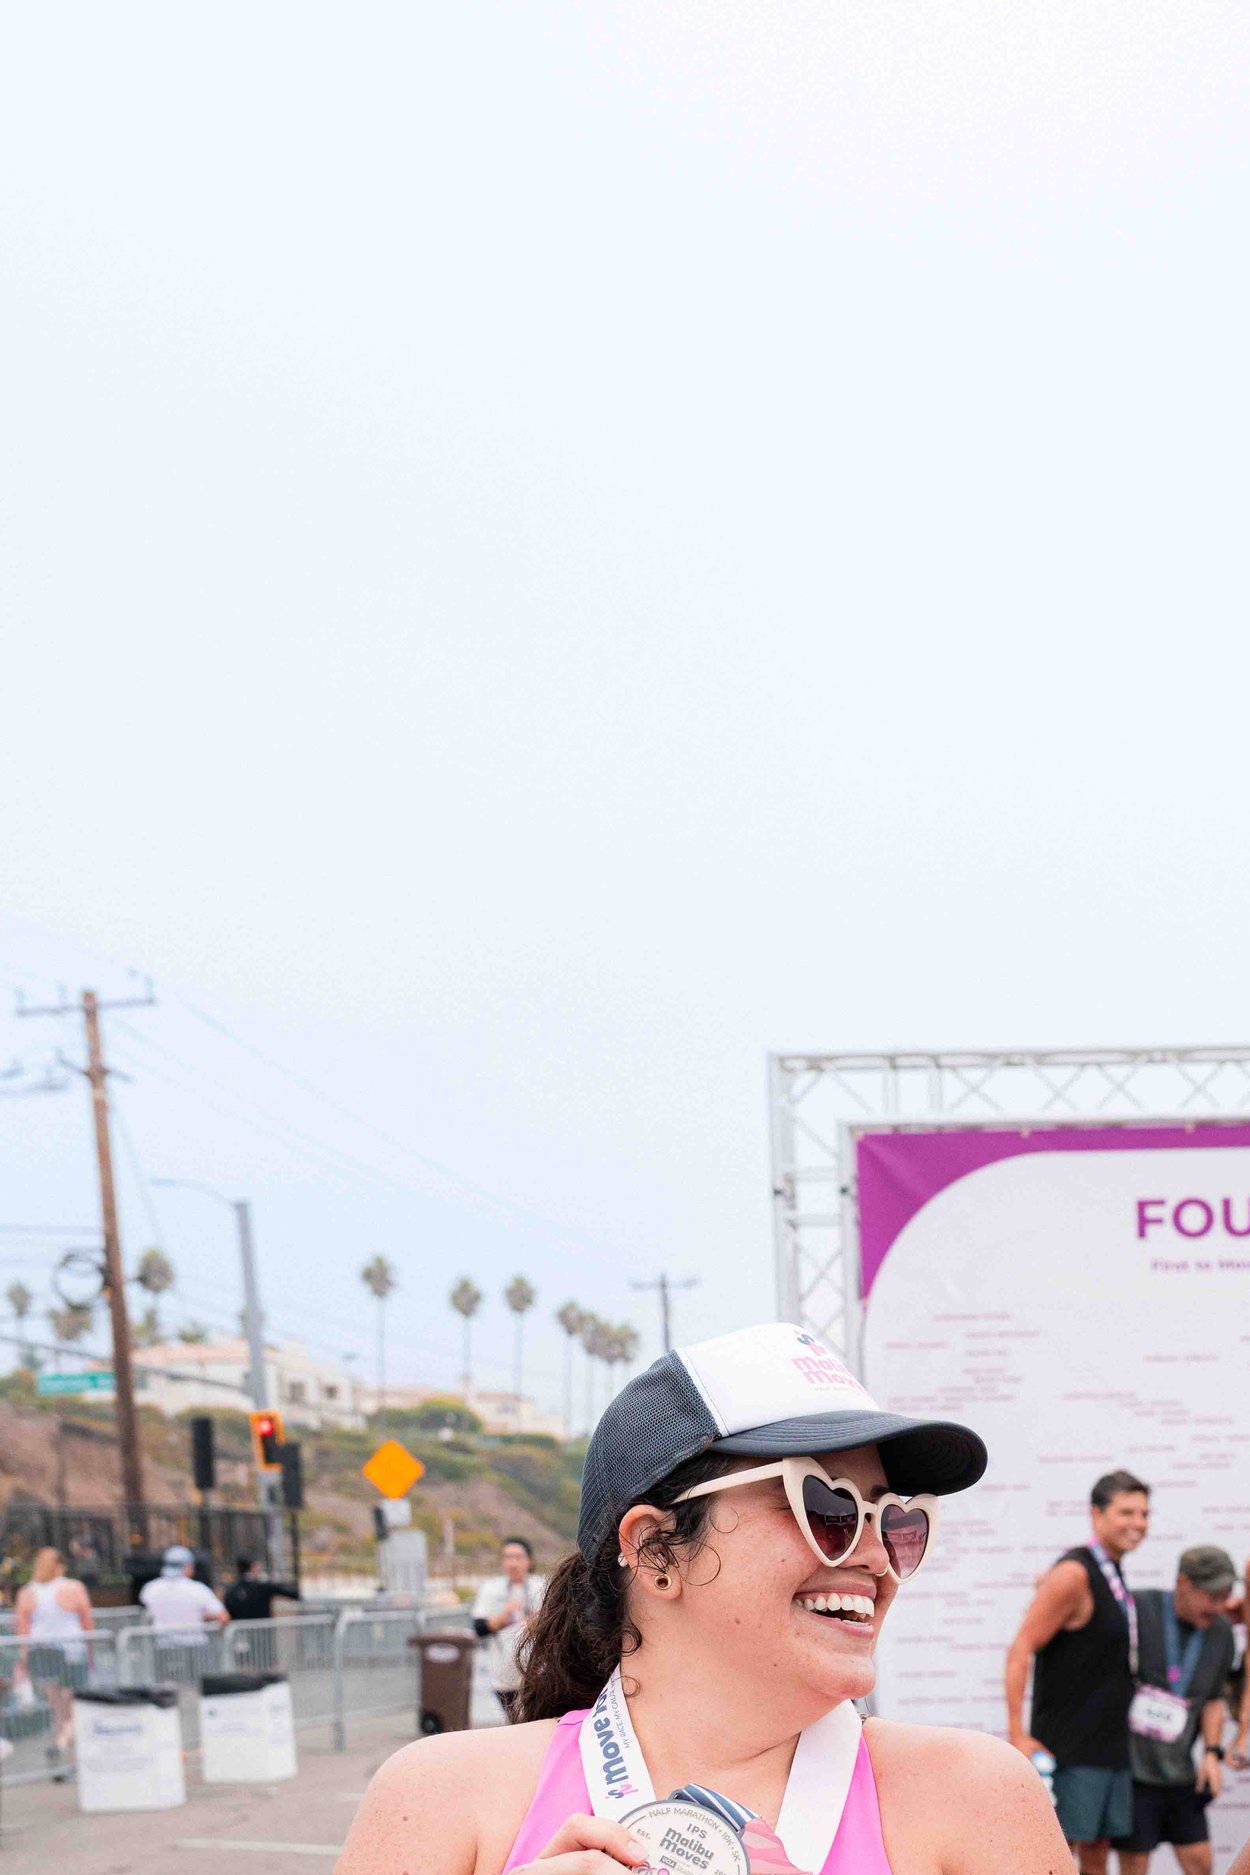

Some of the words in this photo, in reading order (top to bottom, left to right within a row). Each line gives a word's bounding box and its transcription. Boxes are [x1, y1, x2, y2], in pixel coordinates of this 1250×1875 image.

[594, 1717, 629, 1786] move
[649, 1807, 671, 1818] HALF
[673, 1807, 720, 1830] MARATHON
[686, 1823, 708, 1839] IPS
[659, 1837, 710, 1870] moves
[664, 1827, 715, 1861] malibu
